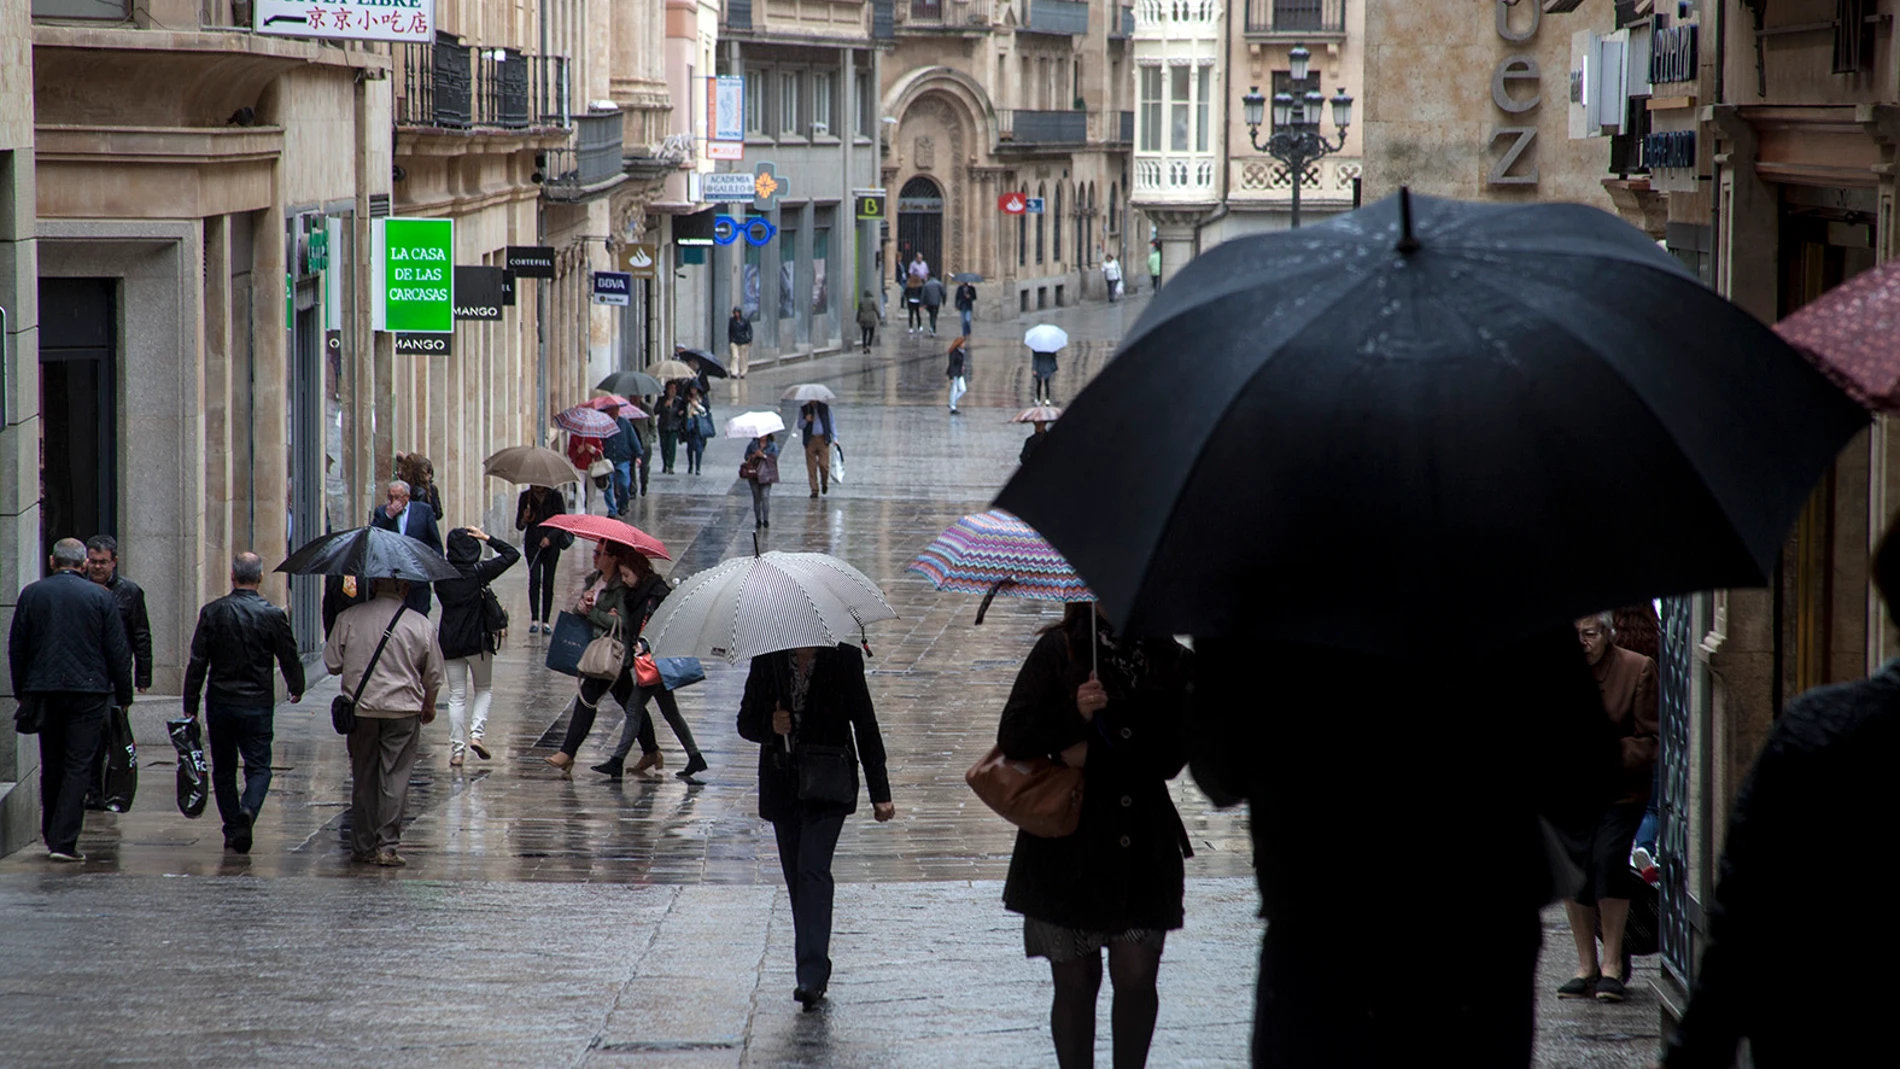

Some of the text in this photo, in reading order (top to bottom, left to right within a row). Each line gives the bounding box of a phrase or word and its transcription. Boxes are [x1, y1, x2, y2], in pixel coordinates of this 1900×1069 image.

[305, 5, 429, 34] 京京小吃店
[710, 175, 750, 184] ACADEMIA
[713, 184, 746, 193] GALILEO
[391, 247, 446, 261] LA CASA
[509, 258, 552, 266] CORTEFIEL
[394, 268, 442, 281] DE LAS
[597, 278, 626, 290] BBVA
[389, 288, 448, 301] CARCASAS
[453, 306, 498, 317] MANGO
[395, 338, 445, 350] MANGO
